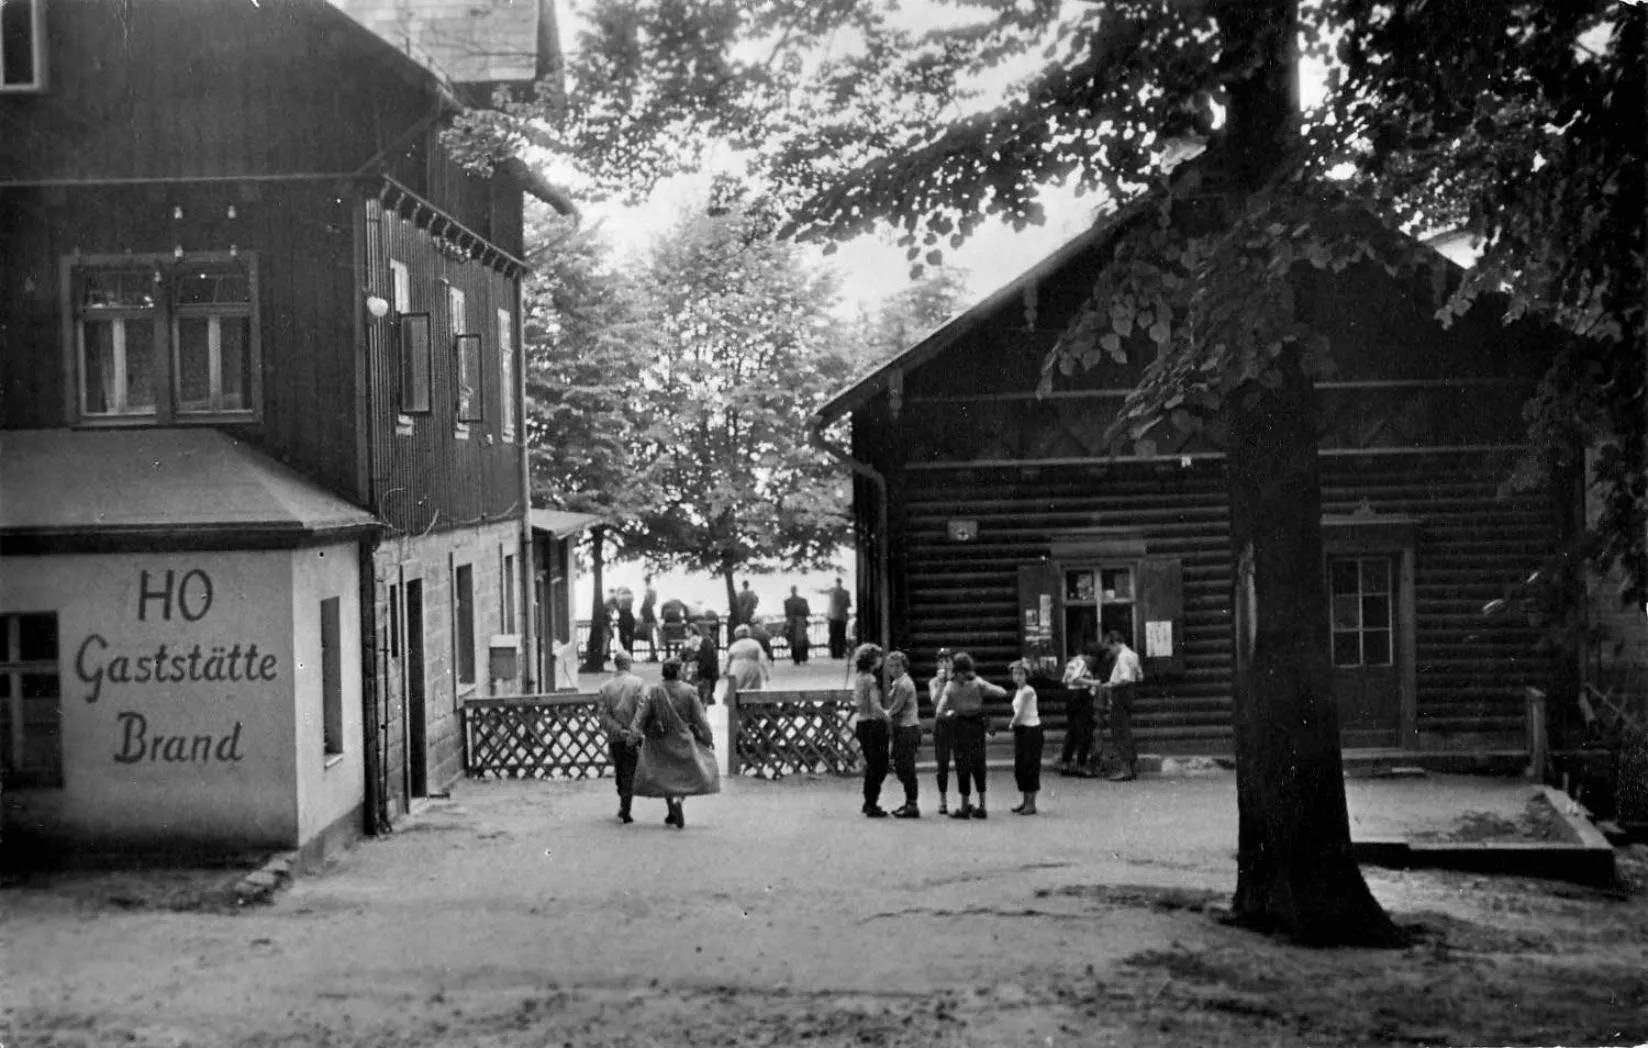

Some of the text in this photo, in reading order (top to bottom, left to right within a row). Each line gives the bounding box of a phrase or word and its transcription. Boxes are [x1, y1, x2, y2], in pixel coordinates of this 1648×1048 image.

[138, 569, 213, 621] HO
[76, 634, 277, 703] Gaststätte
[114, 712, 243, 764] Brand
